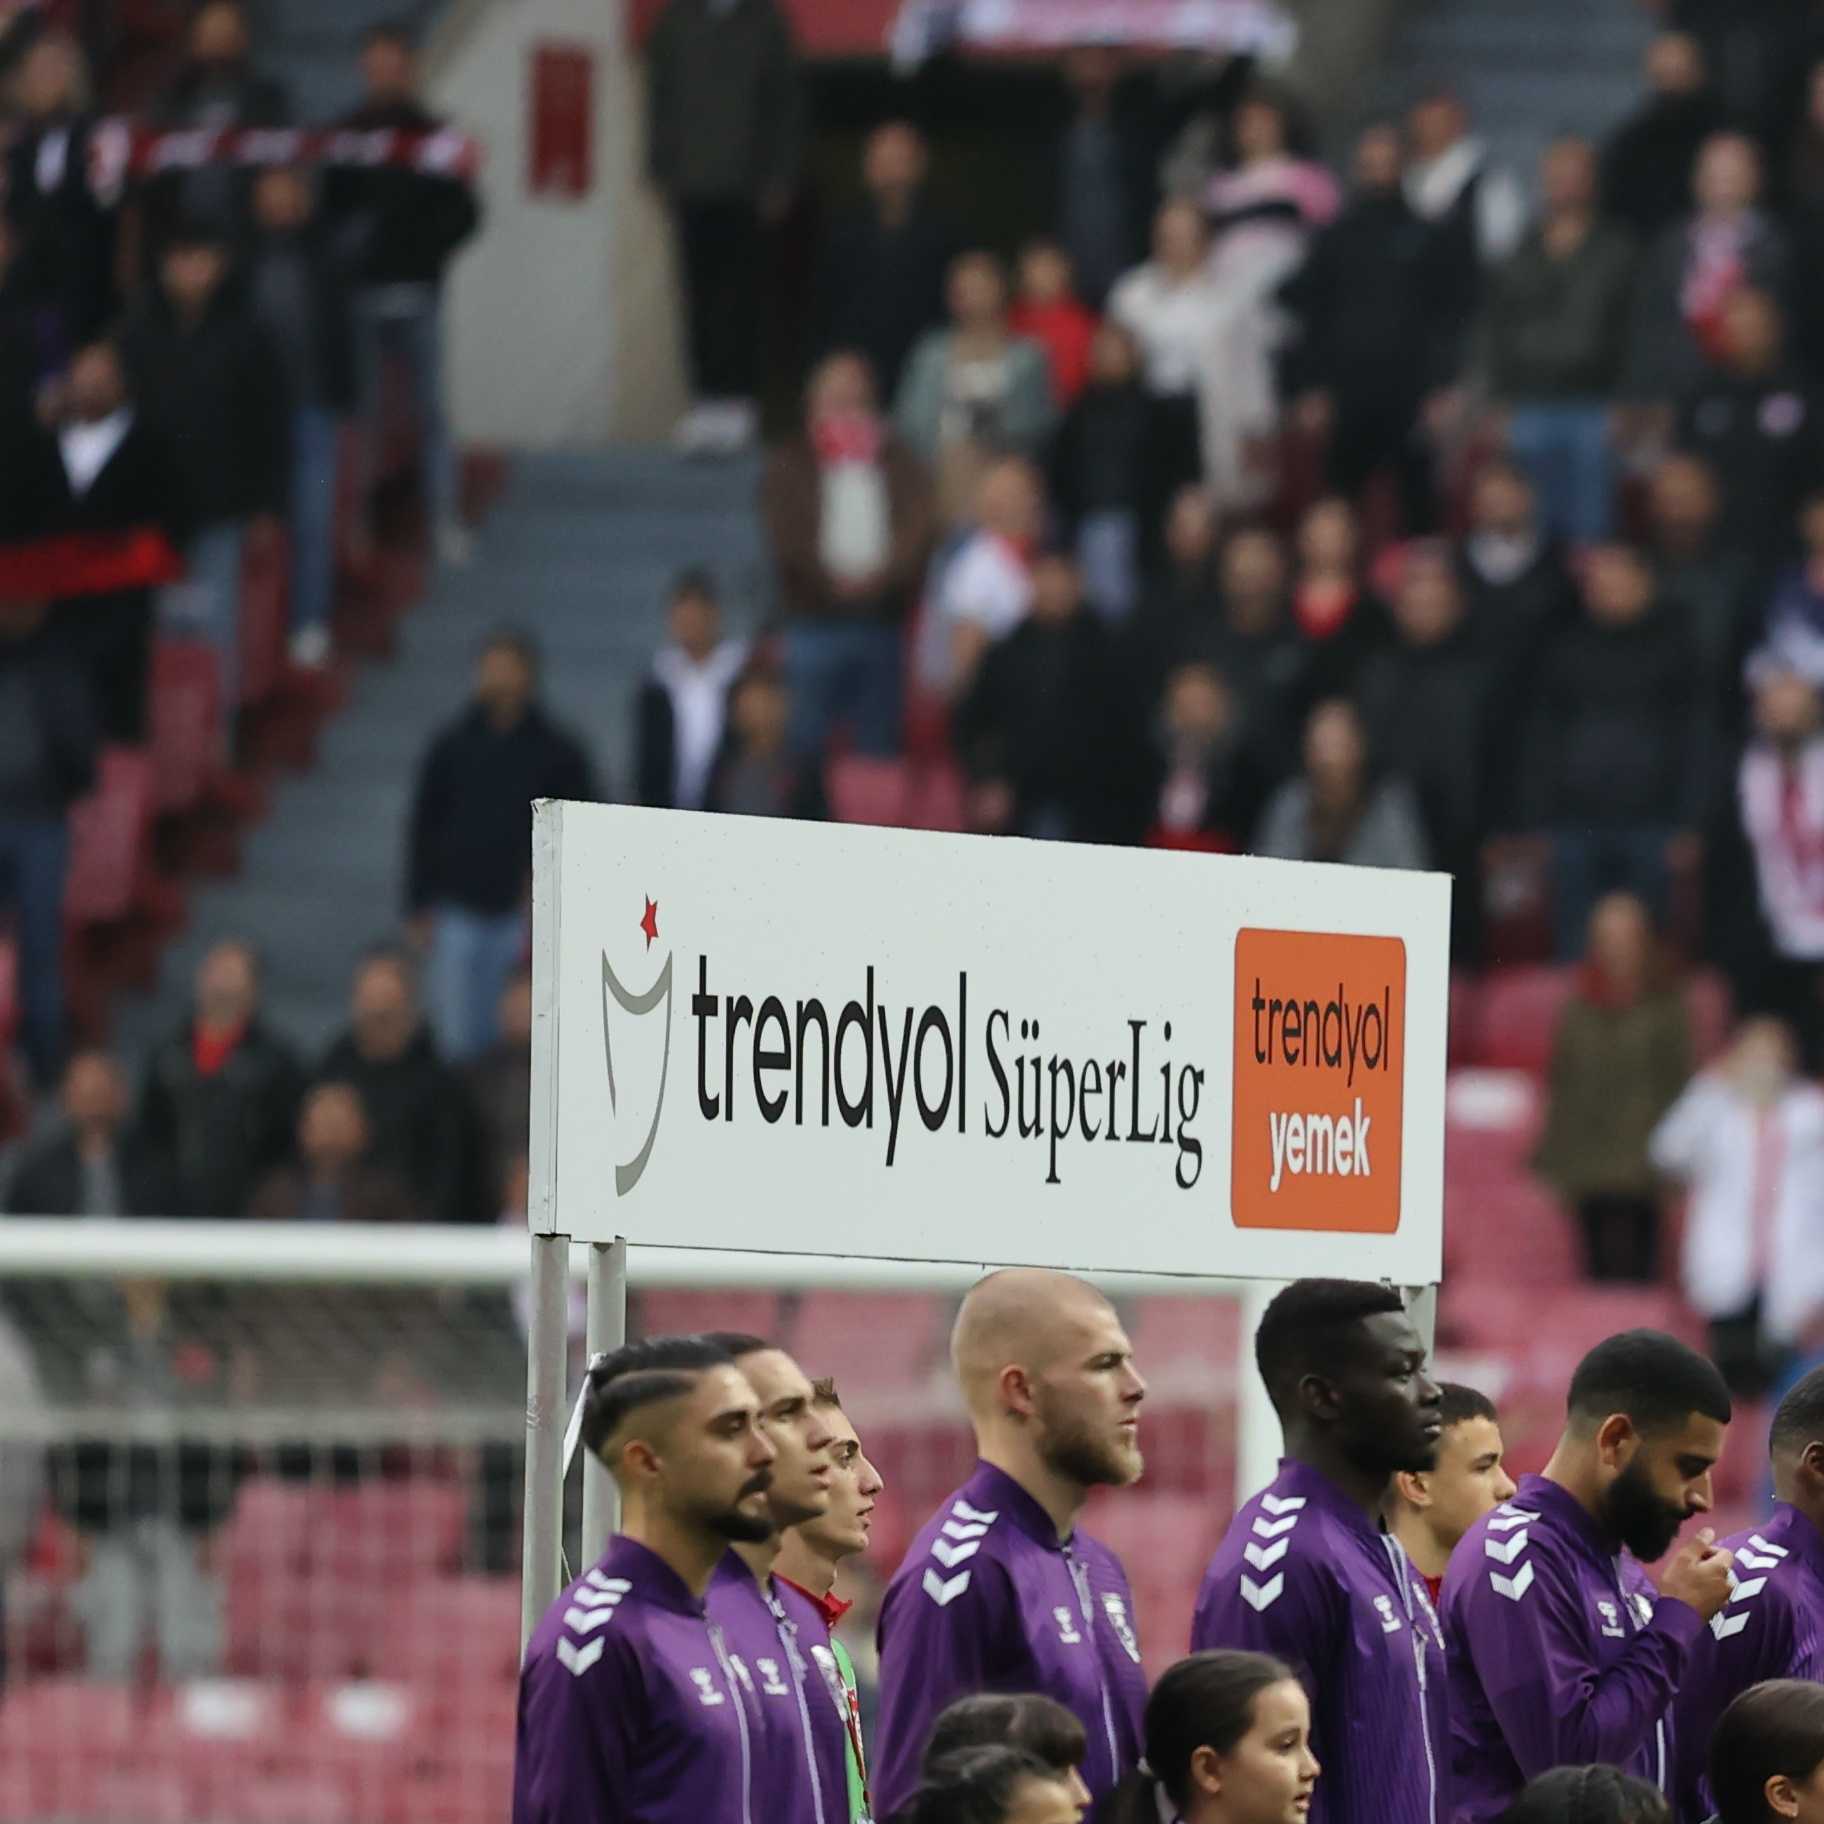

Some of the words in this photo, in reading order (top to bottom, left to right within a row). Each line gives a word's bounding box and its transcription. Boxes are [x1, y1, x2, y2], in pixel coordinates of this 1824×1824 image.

[691, 954, 967, 1167] trendyol
[1251, 977, 1390, 1089] trendyol
[1270, 1097, 1371, 1193] yemek
